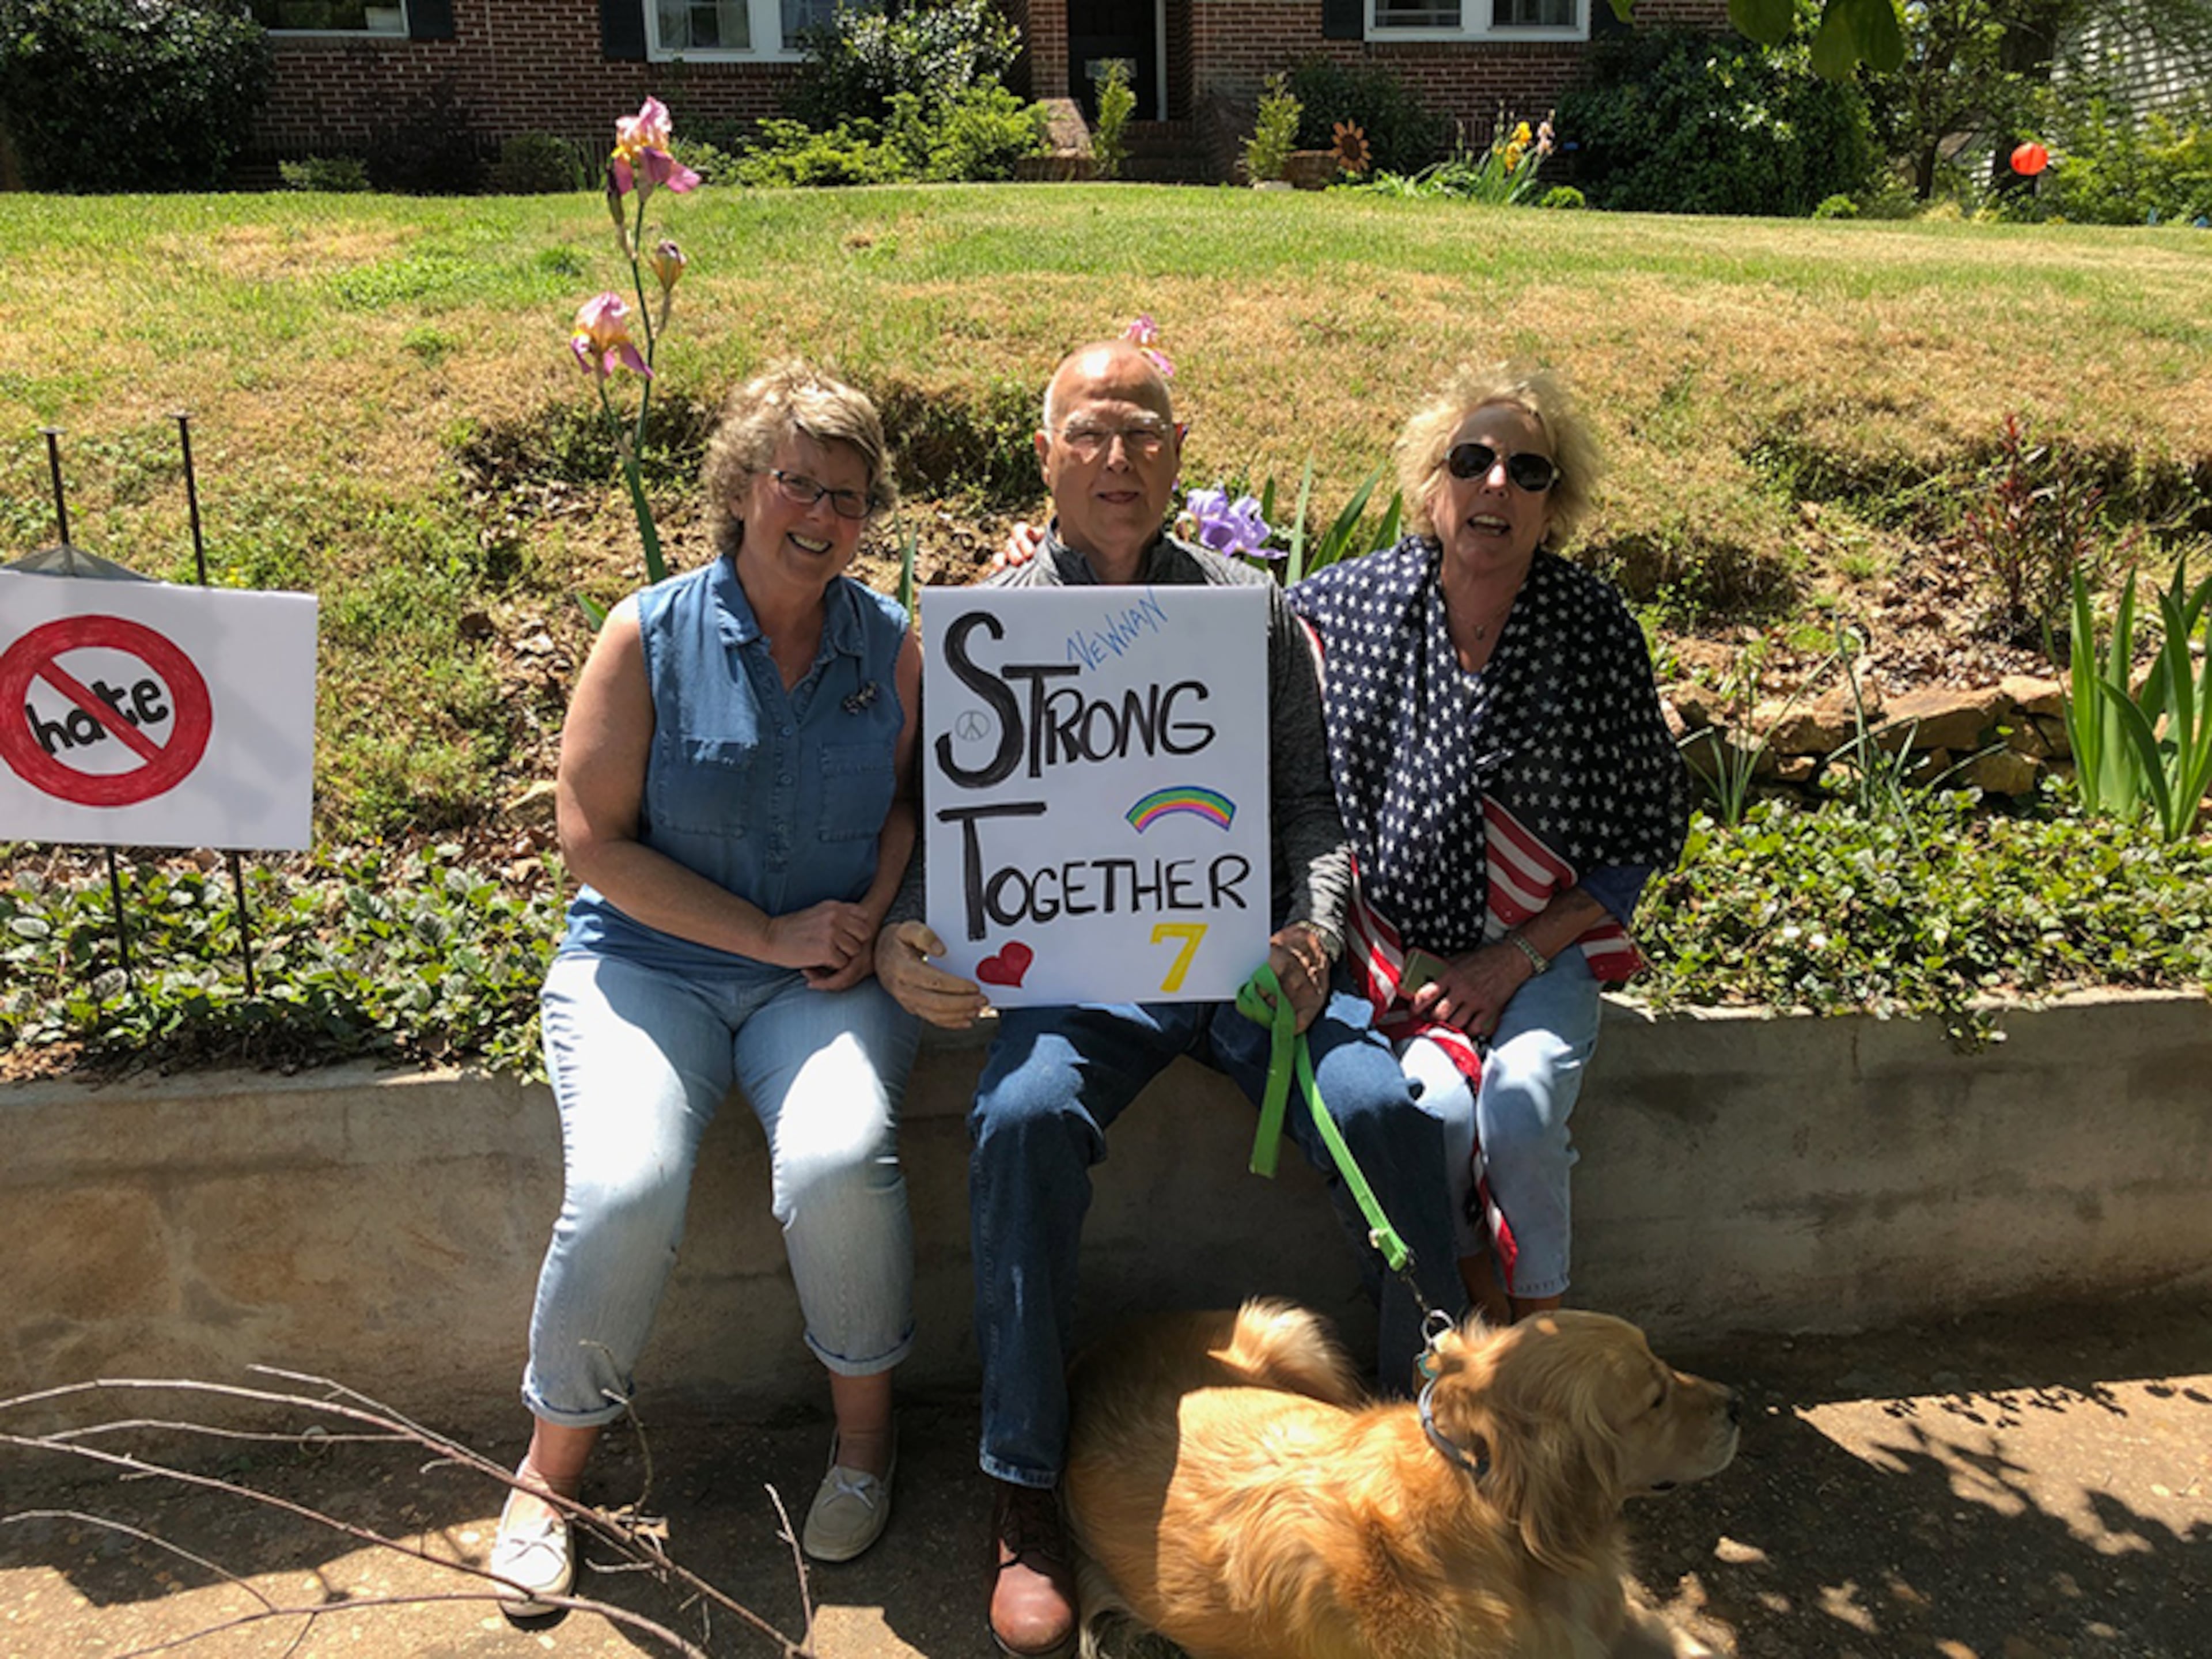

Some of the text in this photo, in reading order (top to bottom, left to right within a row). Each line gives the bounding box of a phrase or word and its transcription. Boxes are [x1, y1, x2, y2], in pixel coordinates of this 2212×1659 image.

[1066, 586, 1168, 671] NEWNAN
[24, 679, 169, 756] hate
[934, 611, 1217, 789] STRONG
[935, 801, 1251, 943] TOGETHER
[1150, 922, 1209, 993] 7
